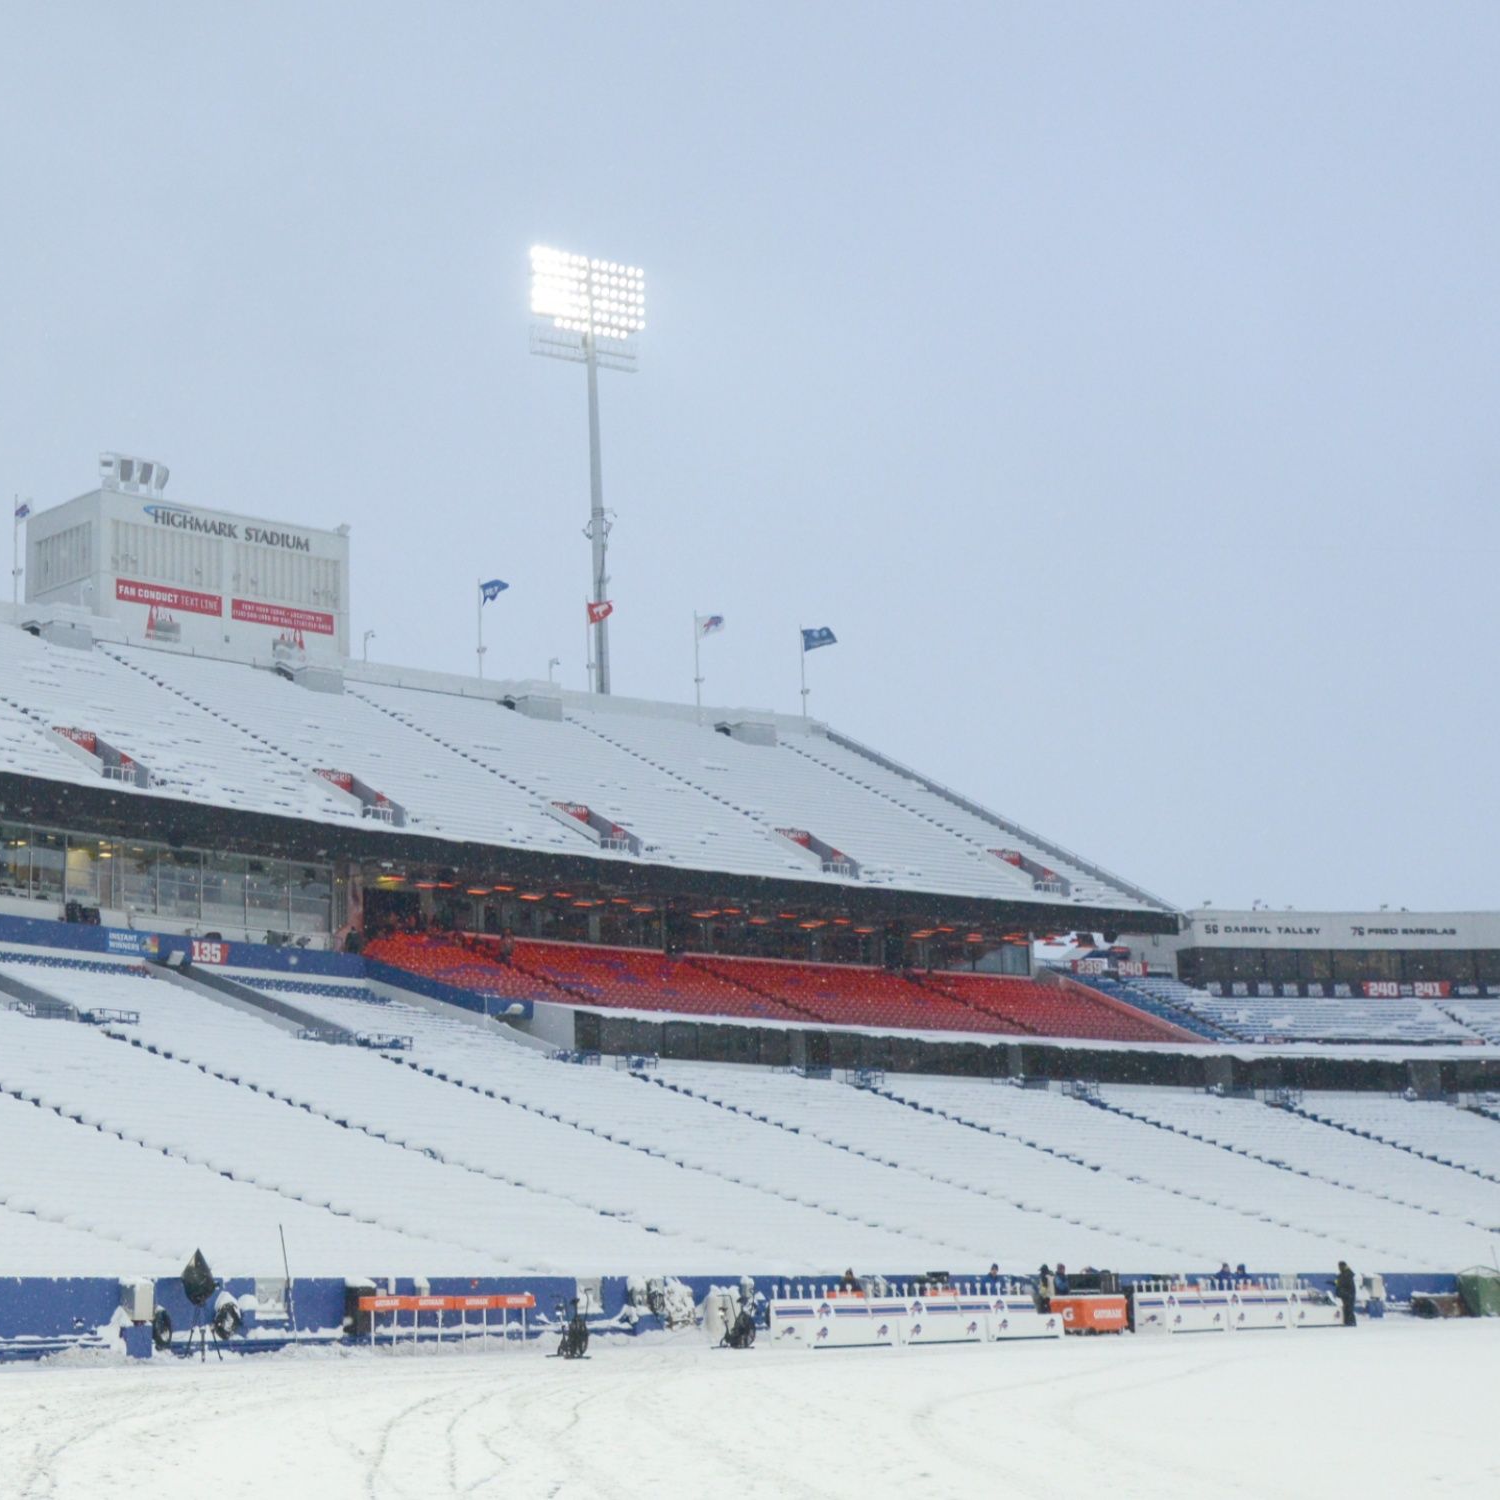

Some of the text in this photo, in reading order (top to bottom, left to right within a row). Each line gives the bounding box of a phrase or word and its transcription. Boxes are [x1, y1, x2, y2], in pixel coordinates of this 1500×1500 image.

[154, 509, 309, 552] HIGHMARK STADIUM
[118, 584, 218, 611] FAN CONDUCT TEXT LINE
[1204, 924, 1320, 935] 56 DARRYL TALLEY
[192, 941, 222, 963] 135
[1077, 960, 1143, 976] 239 240
[1368, 981, 1398, 997] 240
[1414, 981, 1441, 997] 241
[1062, 1307, 1075, 1321] G
